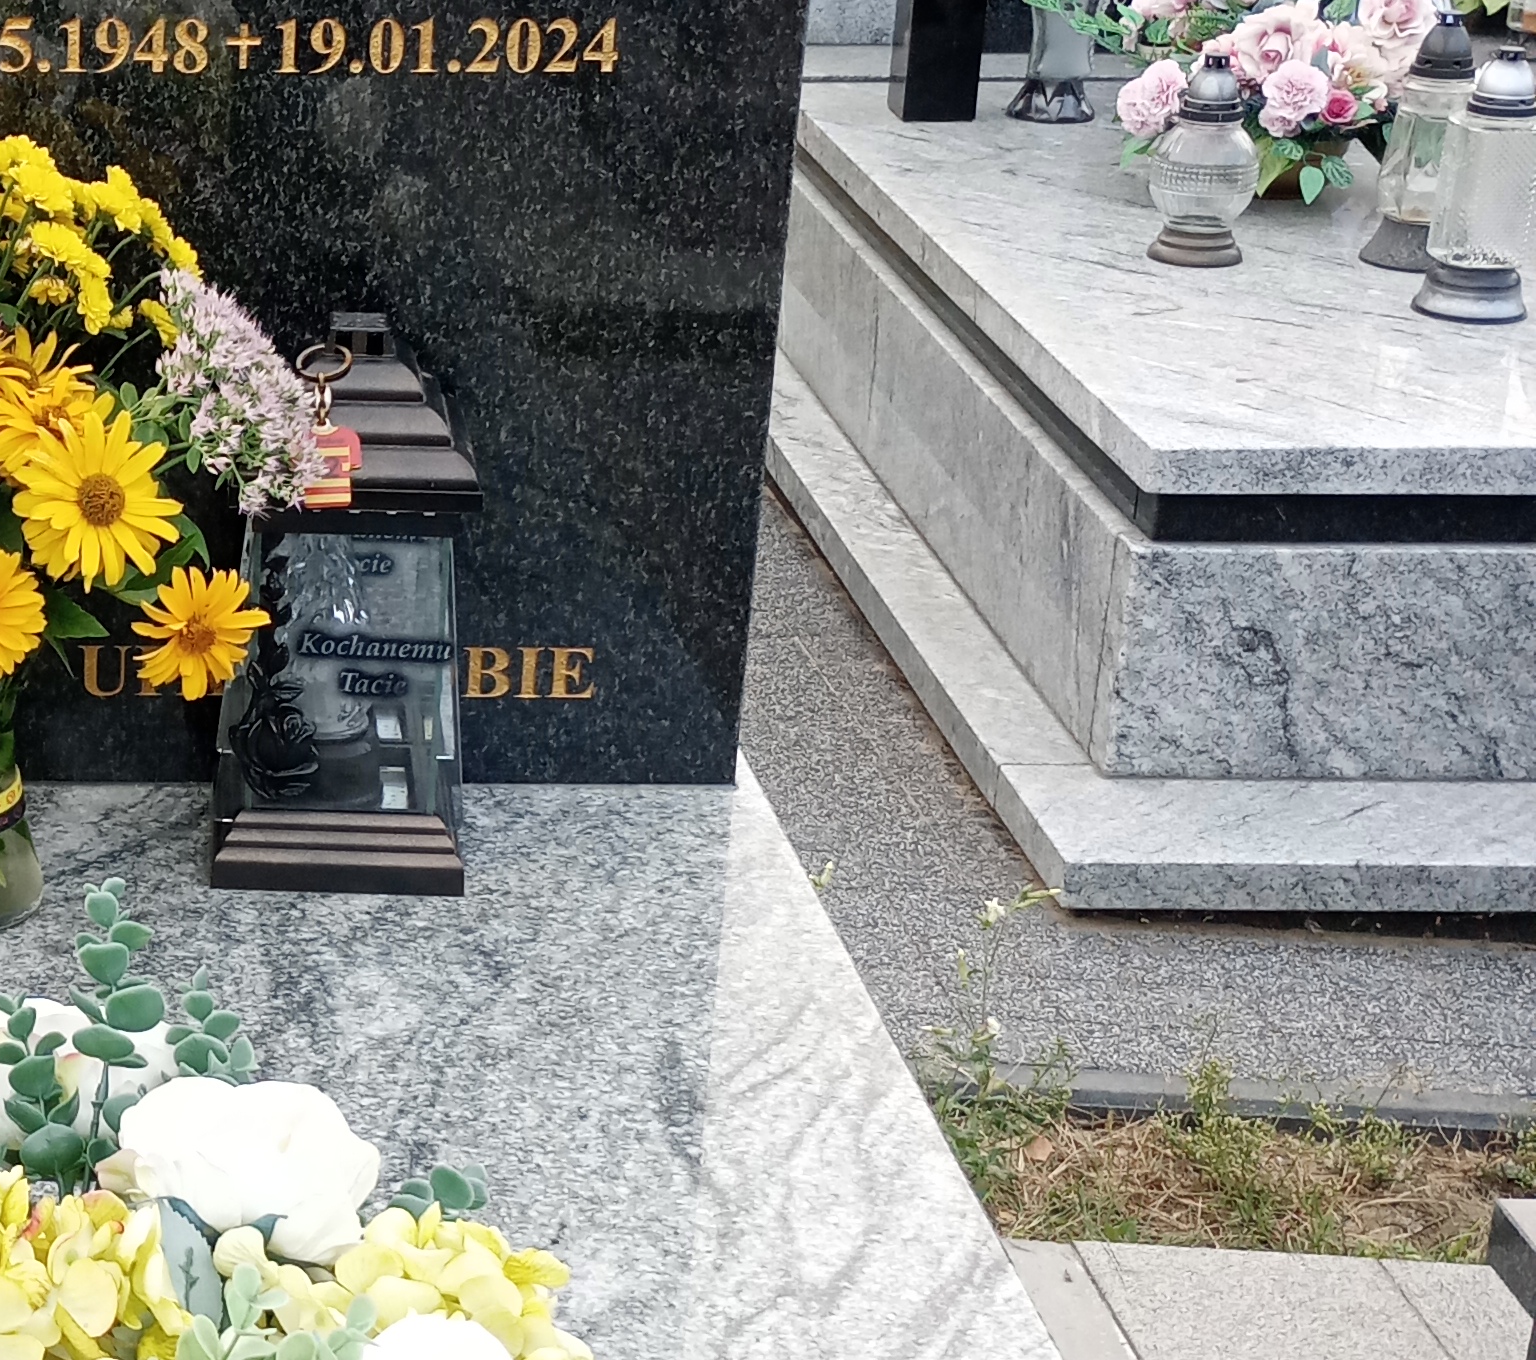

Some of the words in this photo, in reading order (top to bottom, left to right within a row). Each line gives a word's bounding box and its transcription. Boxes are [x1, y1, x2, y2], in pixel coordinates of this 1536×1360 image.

[274, 16, 620, 75] 19.01.2024
[298, 633, 453, 660] Kochanemu
[339, 671, 408, 695] Tacie
[461, 647, 597, 699] BIE
